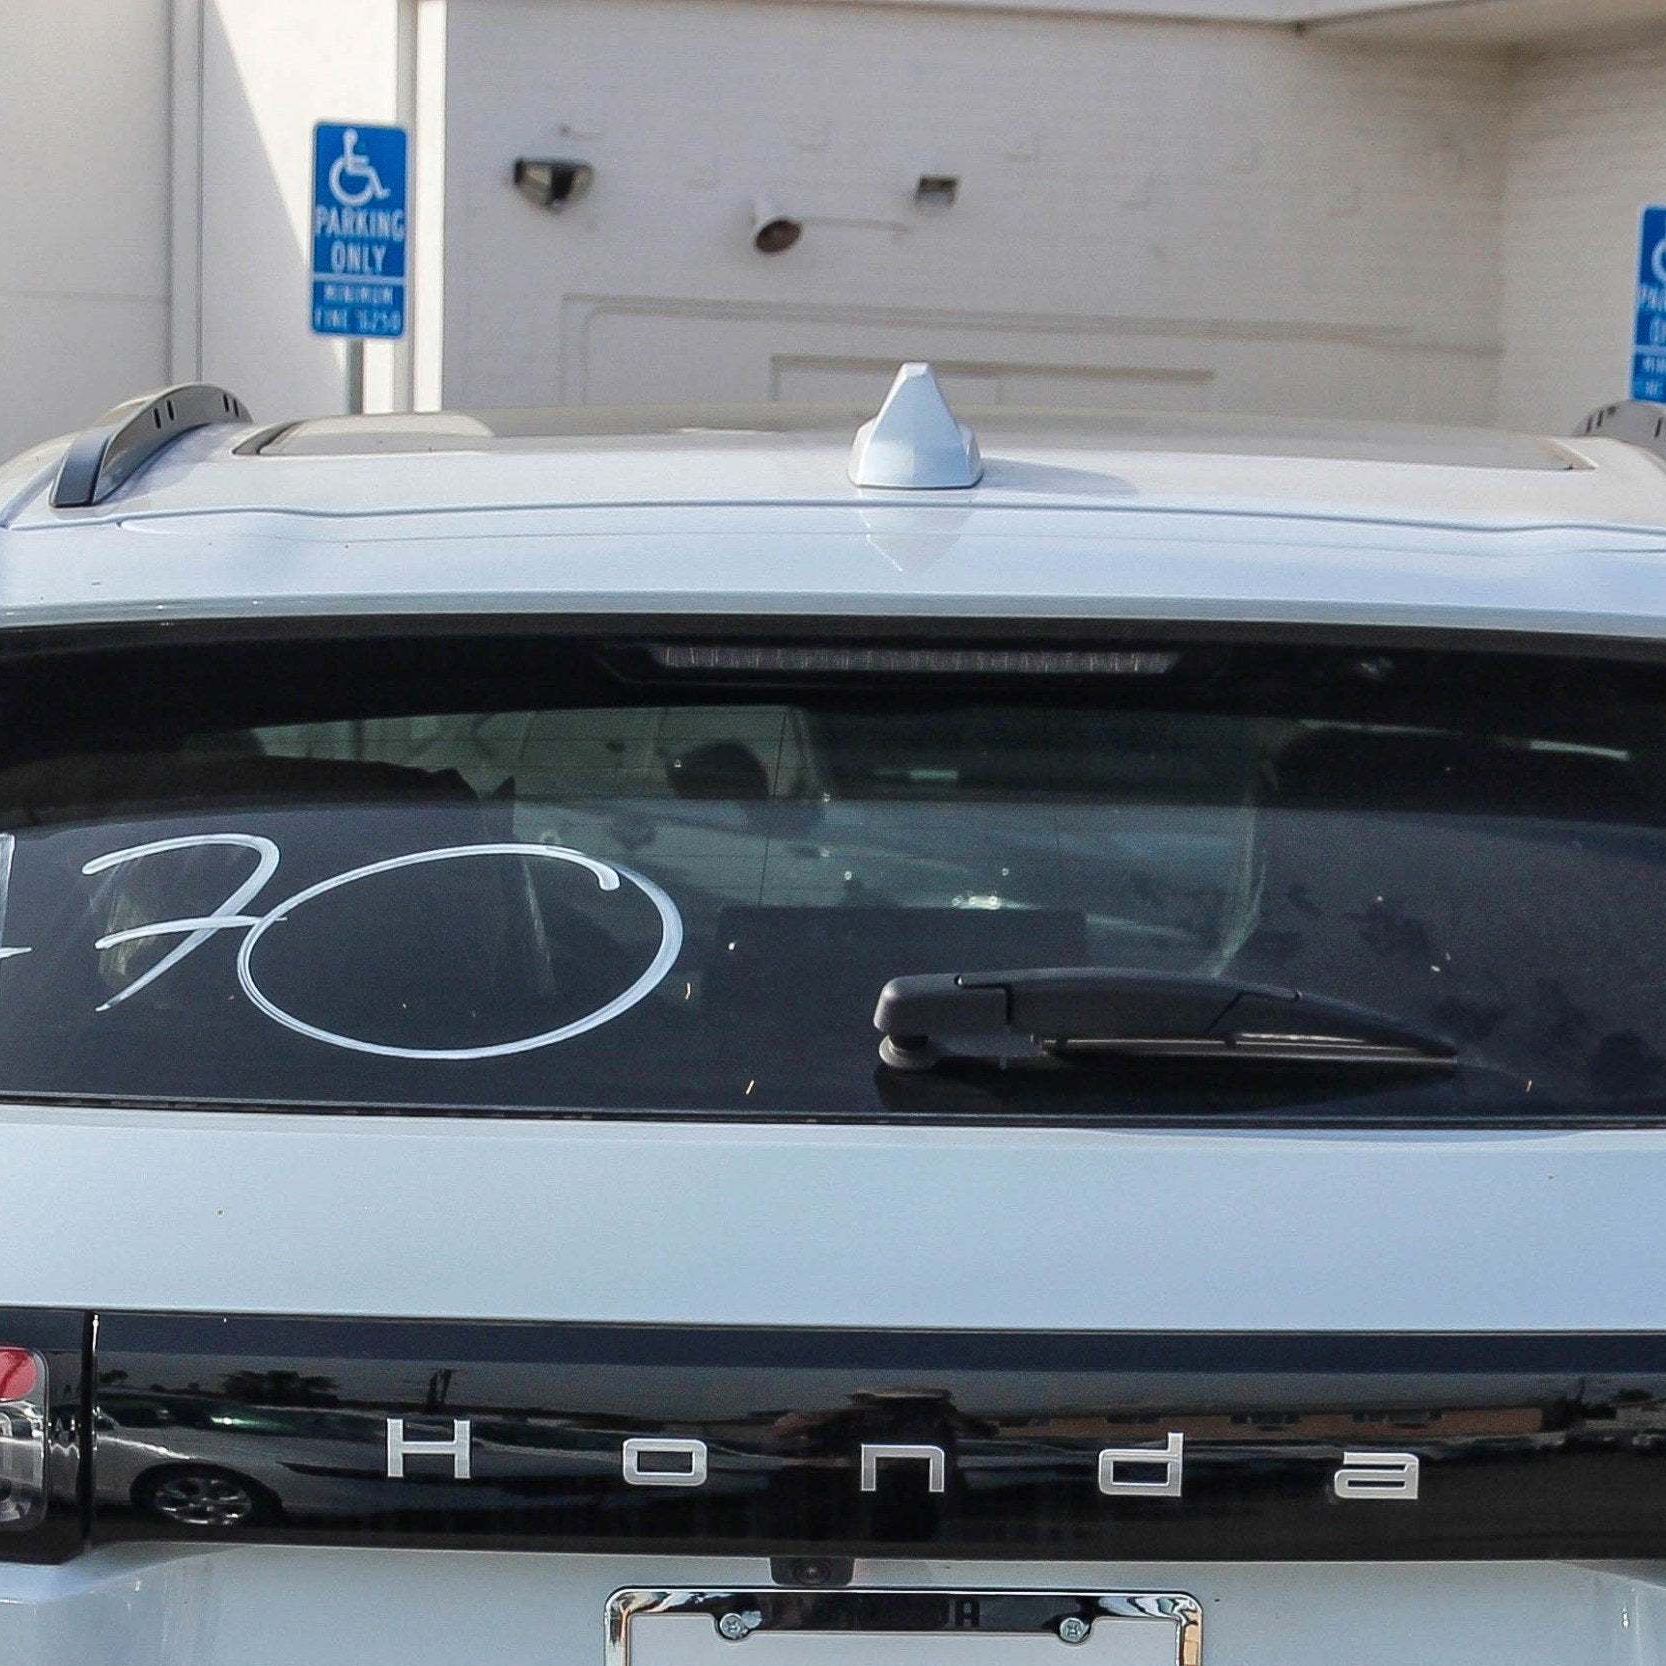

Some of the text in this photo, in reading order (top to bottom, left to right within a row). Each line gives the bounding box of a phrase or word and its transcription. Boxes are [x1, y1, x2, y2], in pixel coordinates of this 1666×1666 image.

[315, 204, 405, 242] PARKING
[331, 241, 386, 274] ONLY
[385, 1417, 1419, 1501] Honda
